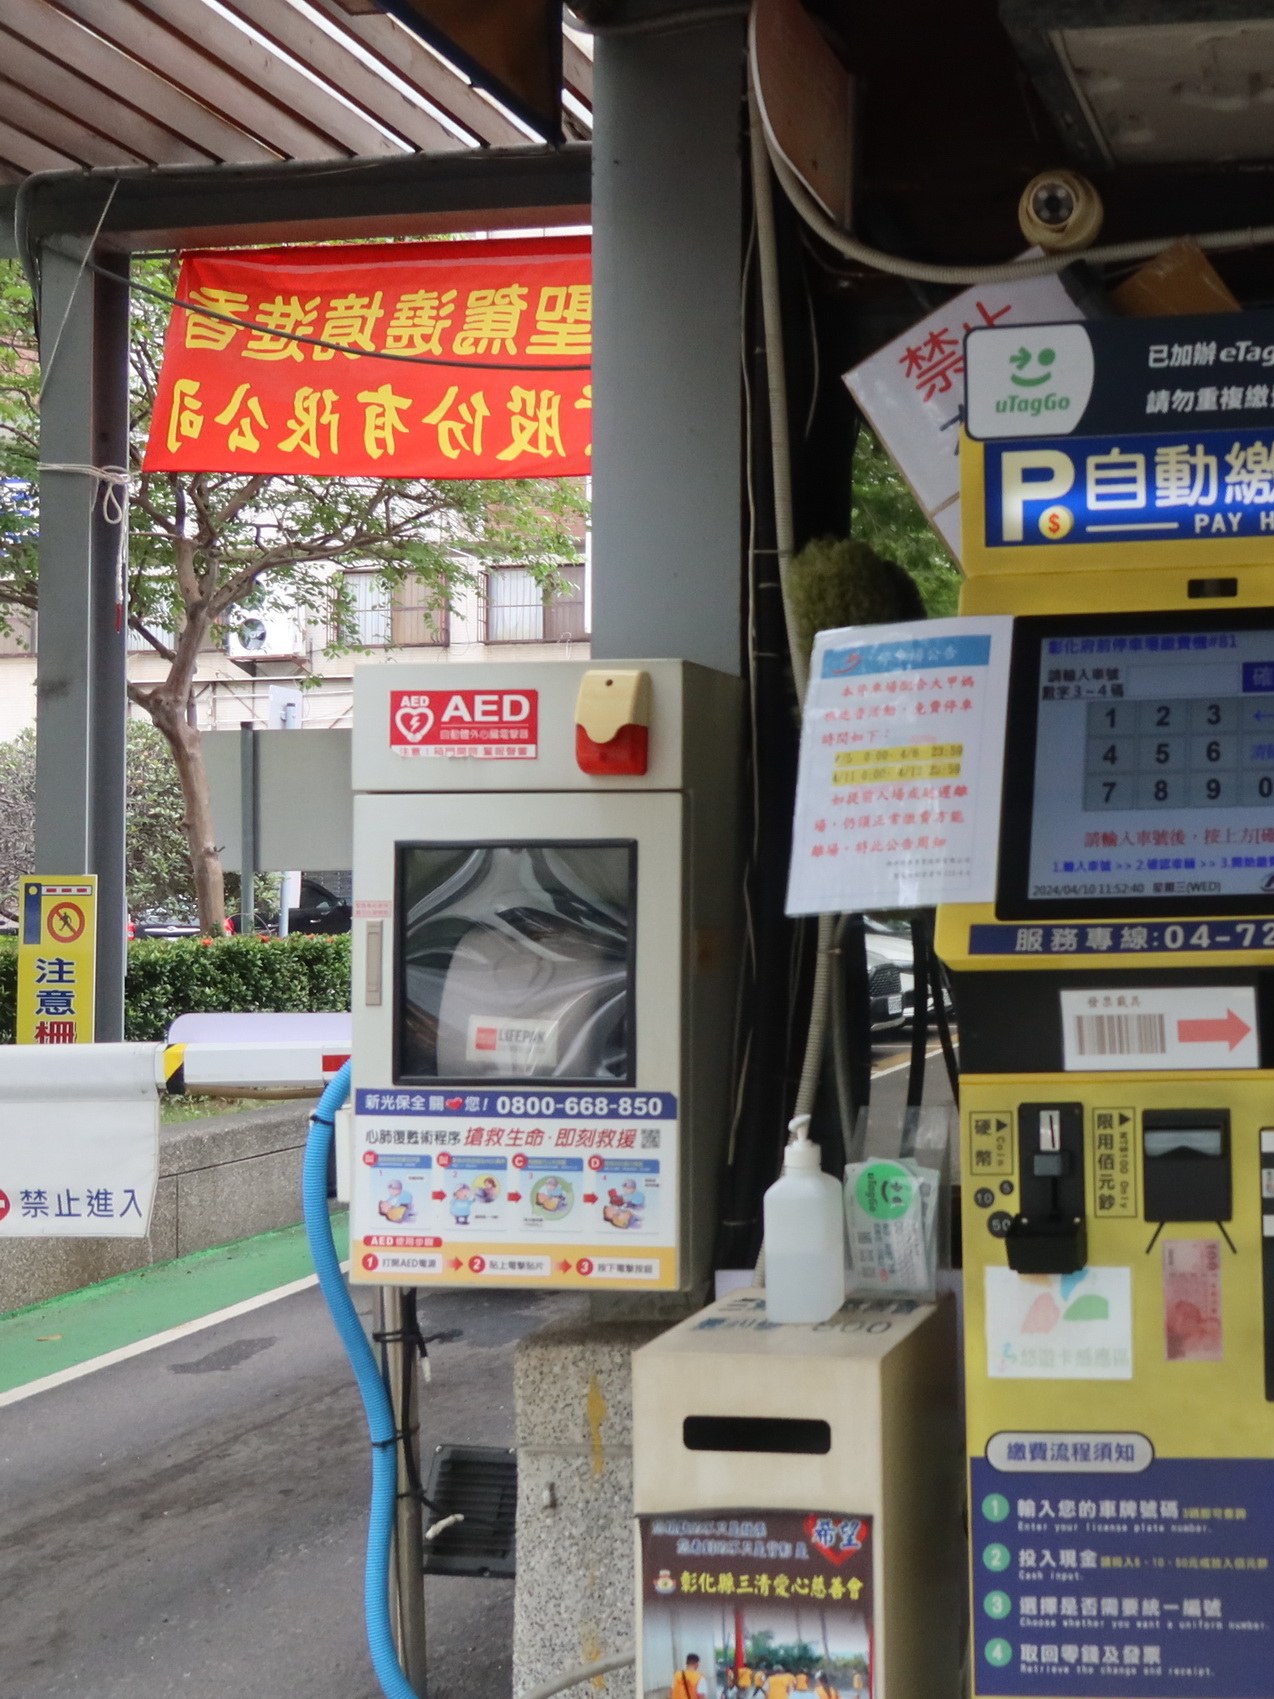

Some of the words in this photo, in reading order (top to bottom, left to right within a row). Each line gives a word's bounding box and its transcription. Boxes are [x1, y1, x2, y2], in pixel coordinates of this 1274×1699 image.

[995, 392, 1070, 416] uTagGo
[1001, 450, 1075, 542] P
[1195, 511, 1241, 534] PAY
[841, 675, 975, 698] 本停車場配合大甲媽
[401, 695, 430, 707] AED
[440, 694, 530, 722] AED
[1106, 708, 1116, 727] 1
[1156, 706, 1170, 726] 2
[1207, 704, 1221, 724] 3
[1103, 745, 1117, 764] 4
[1156, 744, 1169, 763] 5
[1207, 742, 1220, 762] 6
[1103, 783, 1116, 802] 7
[1154, 781, 1168, 801] 8
[1206, 779, 1220, 799] 9
[1259, 777, 1273, 797] 0
[1033, 884, 1096, 896] 2024/04/10
[1099, 883, 1145, 894] 11:52:40
[365, 1094, 425, 1110] 新光保全
[497, 1096, 662, 1116] 0800-668-850
[365, 1129, 460, 1145] 心肺復甦術程序
[975, 1119, 991, 1166] 硬幣
[996, 1136, 1005, 1166] Coin
[1097, 1114, 1115, 1210] 限用佰元鈔
[20, 1189, 143, 1218] 禁止進入
[976, 1193, 992, 1203] 10
[992, 1219, 1011, 1231] 50
[1007, 1442, 1135, 1462] 繳費流程須知
[1018, 1500, 1179, 1519] 輸入您的車牌號碼
[812, 1518, 862, 1550] 希望
[1018, 1522, 1048, 1532] Enter
[1055, 1523, 1078, 1533] your
[1018, 1549, 1098, 1569] 投入現金
[680, 1570, 863, 1600] 彰化縣三清愛心慈善會
[1018, 1570, 1043, 1580] Cash
[1019, 1596, 1222, 1618] 選擇是否需要統一編號
[1020, 1644, 1161, 1665] 取回零錢及發票
